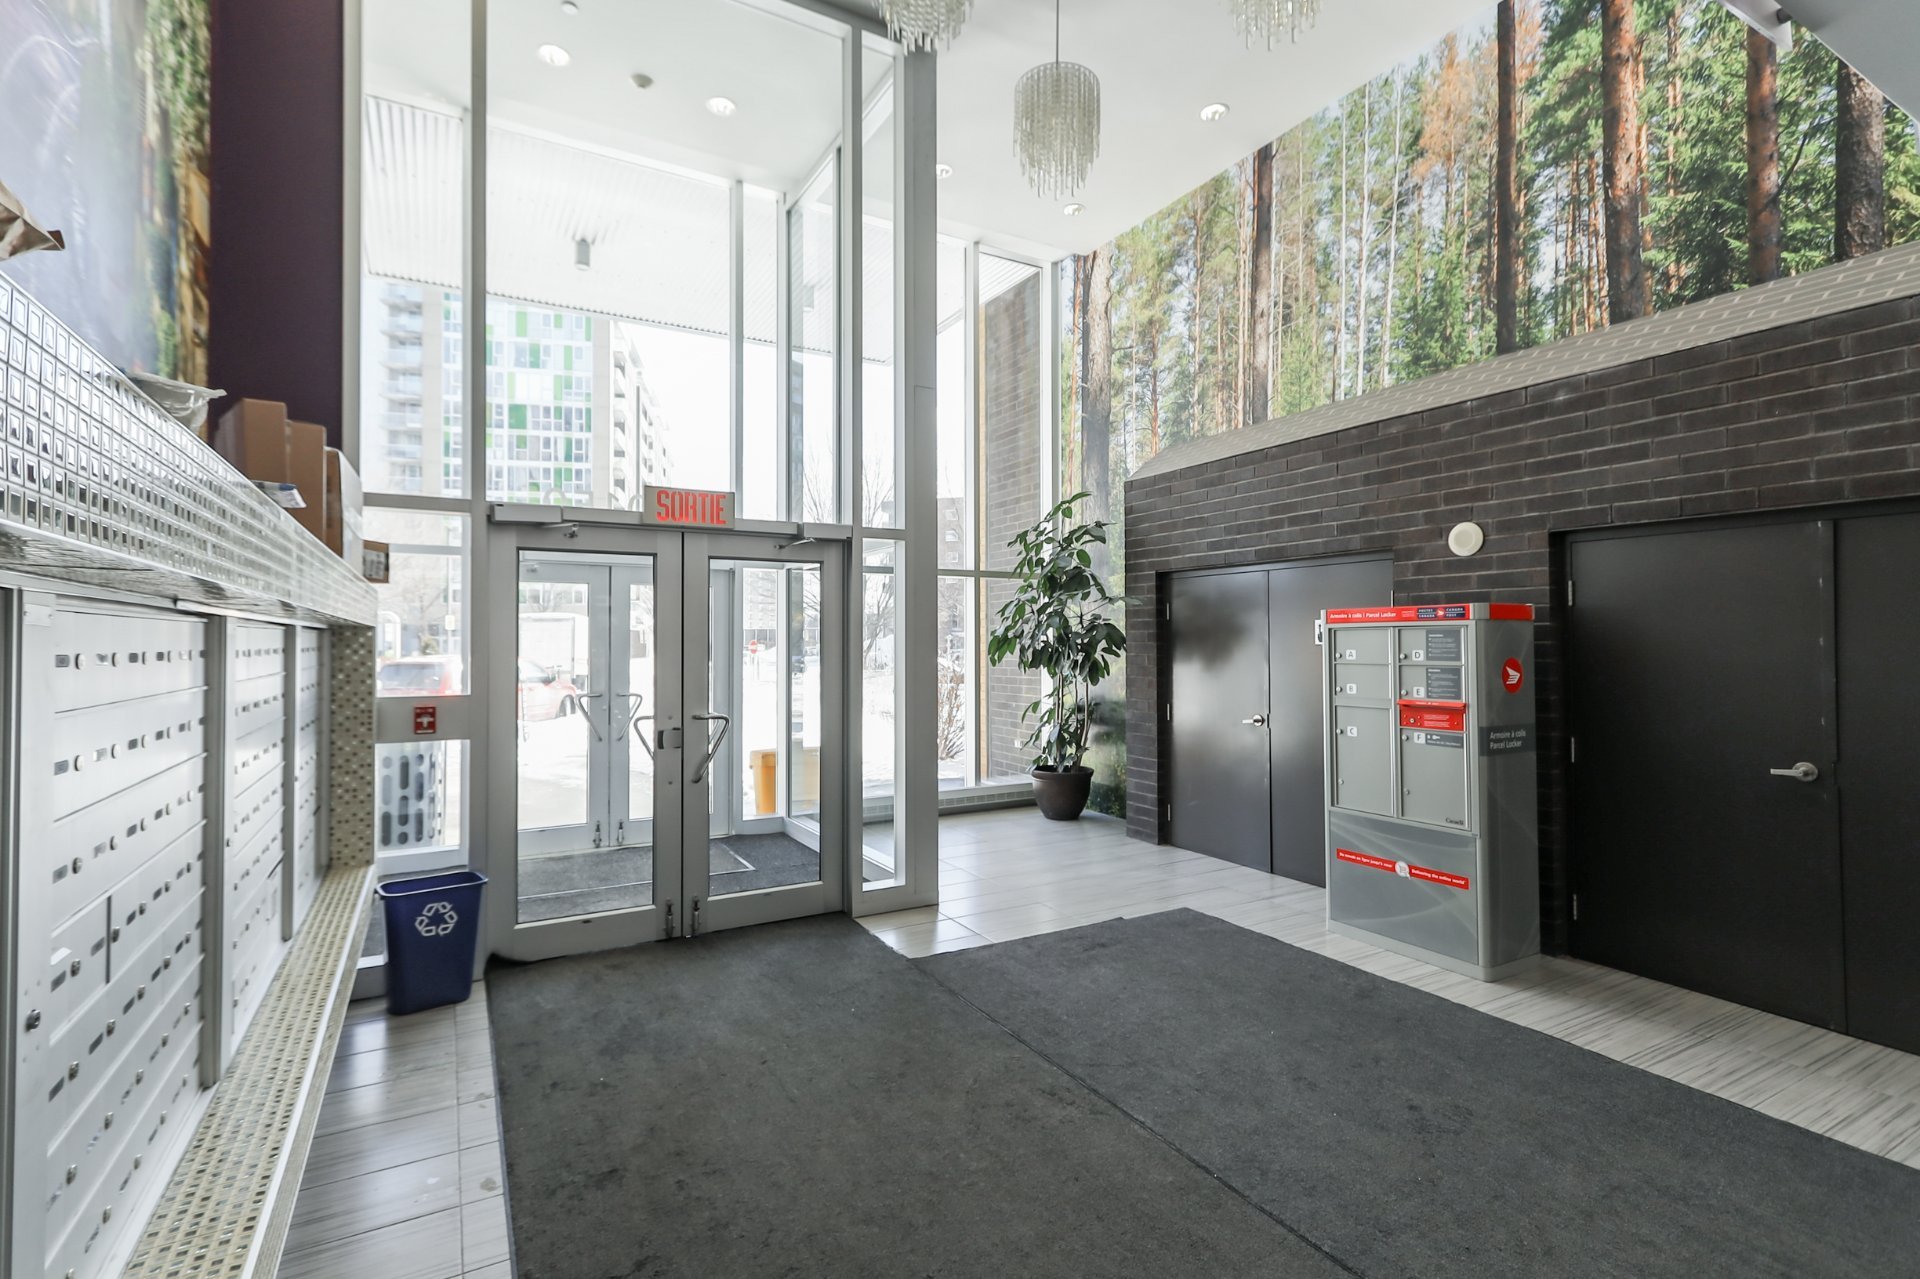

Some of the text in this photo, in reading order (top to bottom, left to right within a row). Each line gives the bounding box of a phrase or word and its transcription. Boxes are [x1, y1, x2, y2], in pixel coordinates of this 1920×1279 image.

[656, 489, 727, 525] SORTIE
[1414, 651, 1421, 659] D
[1416, 688, 1421, 696] E
[1349, 727, 1355, 735] C
[1490, 731, 1510, 739] Armoire
[1515, 729, 1527, 737] colis
[1506, 740, 1522, 748] Locker
